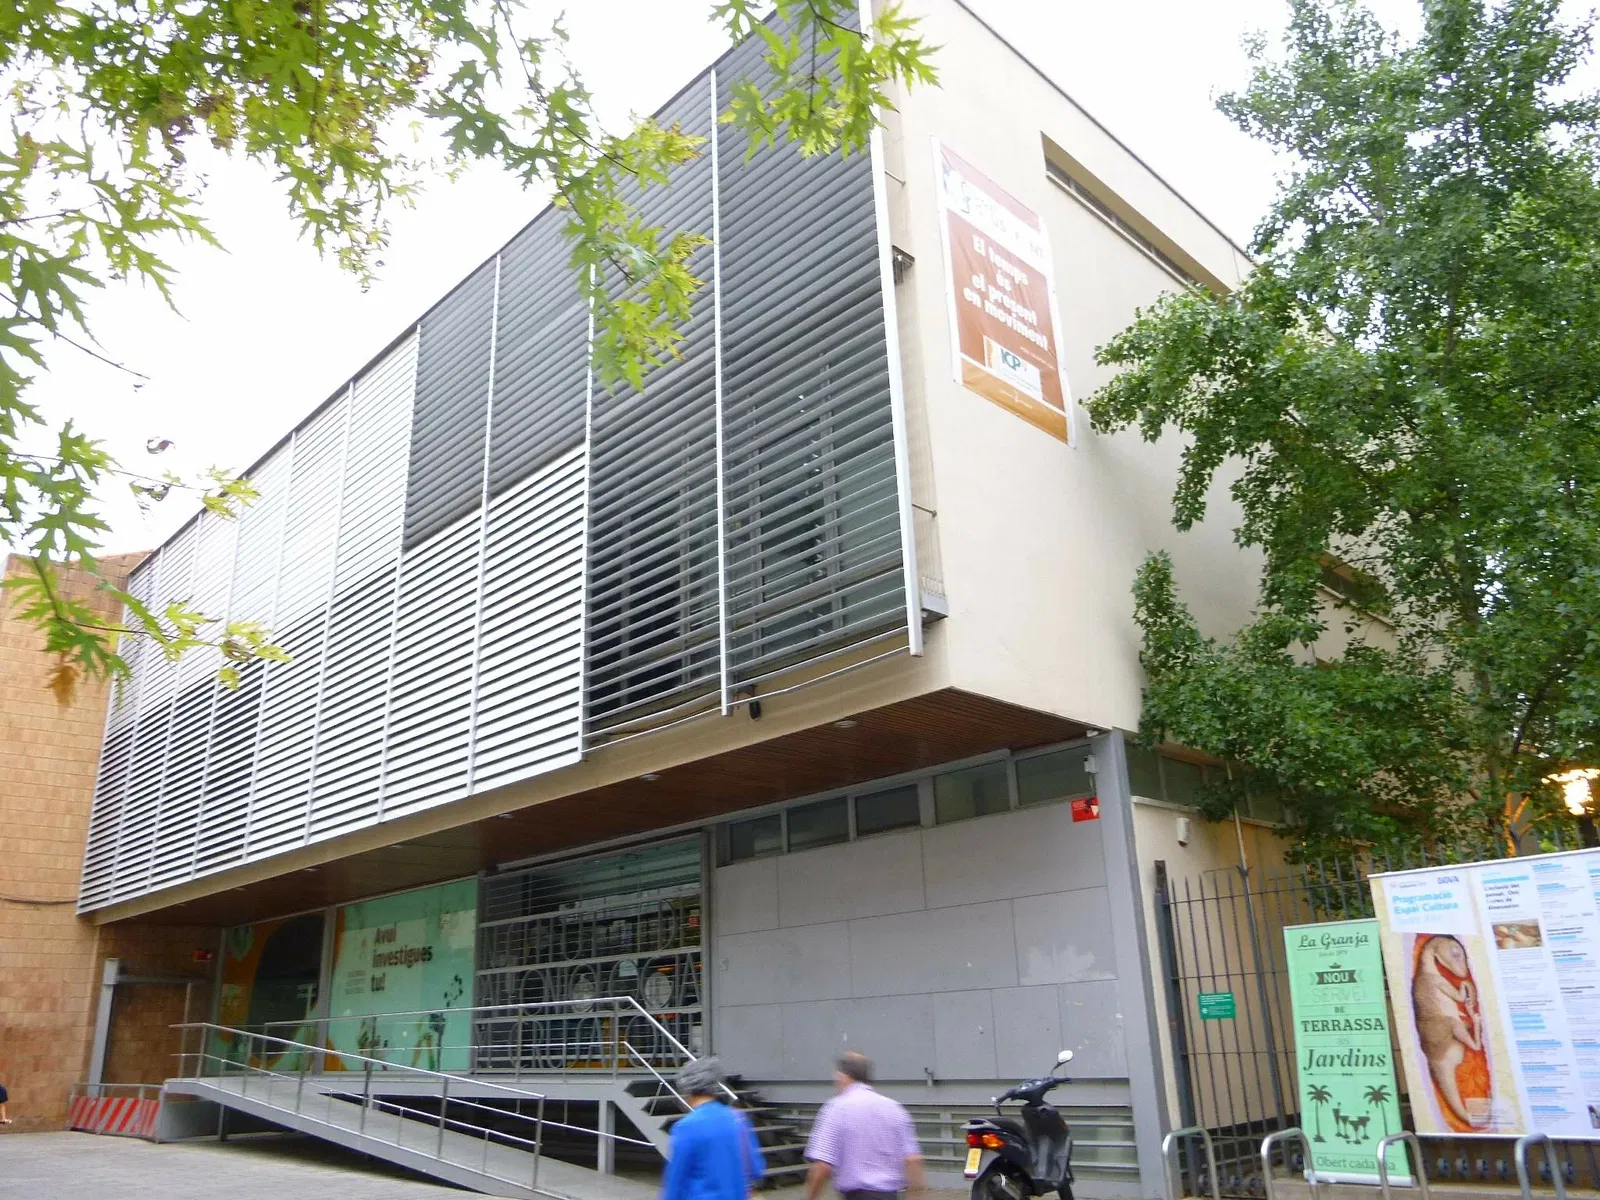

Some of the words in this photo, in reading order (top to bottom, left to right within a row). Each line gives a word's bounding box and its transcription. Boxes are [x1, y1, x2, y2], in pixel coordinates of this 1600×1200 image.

[972, 234, 985, 256] El
[988, 246, 1028, 286] temps
[972, 273, 986, 292] el
[988, 285, 1037, 326] present
[963, 287, 981, 308] en
[984, 300, 1048, 351] moviment
[1392, 892, 1452, 904] Programació
[1395, 905, 1419, 915] Espai
[1423, 903, 1458, 912] Cultura
[374, 922, 397, 945] Avui
[1299, 933, 1316, 948] La
[1321, 931, 1369, 949] Granja
[372, 945, 433, 968] investigues
[371, 972, 386, 992] tu!
[1323, 972, 1349, 983] NOU
[1301, 1018, 1385, 1032] TERRASSA
[1303, 1048, 1386, 1071] Jardins
[1316, 1156, 1347, 1168] Obert
[1349, 1157, 1376, 1169] cada
